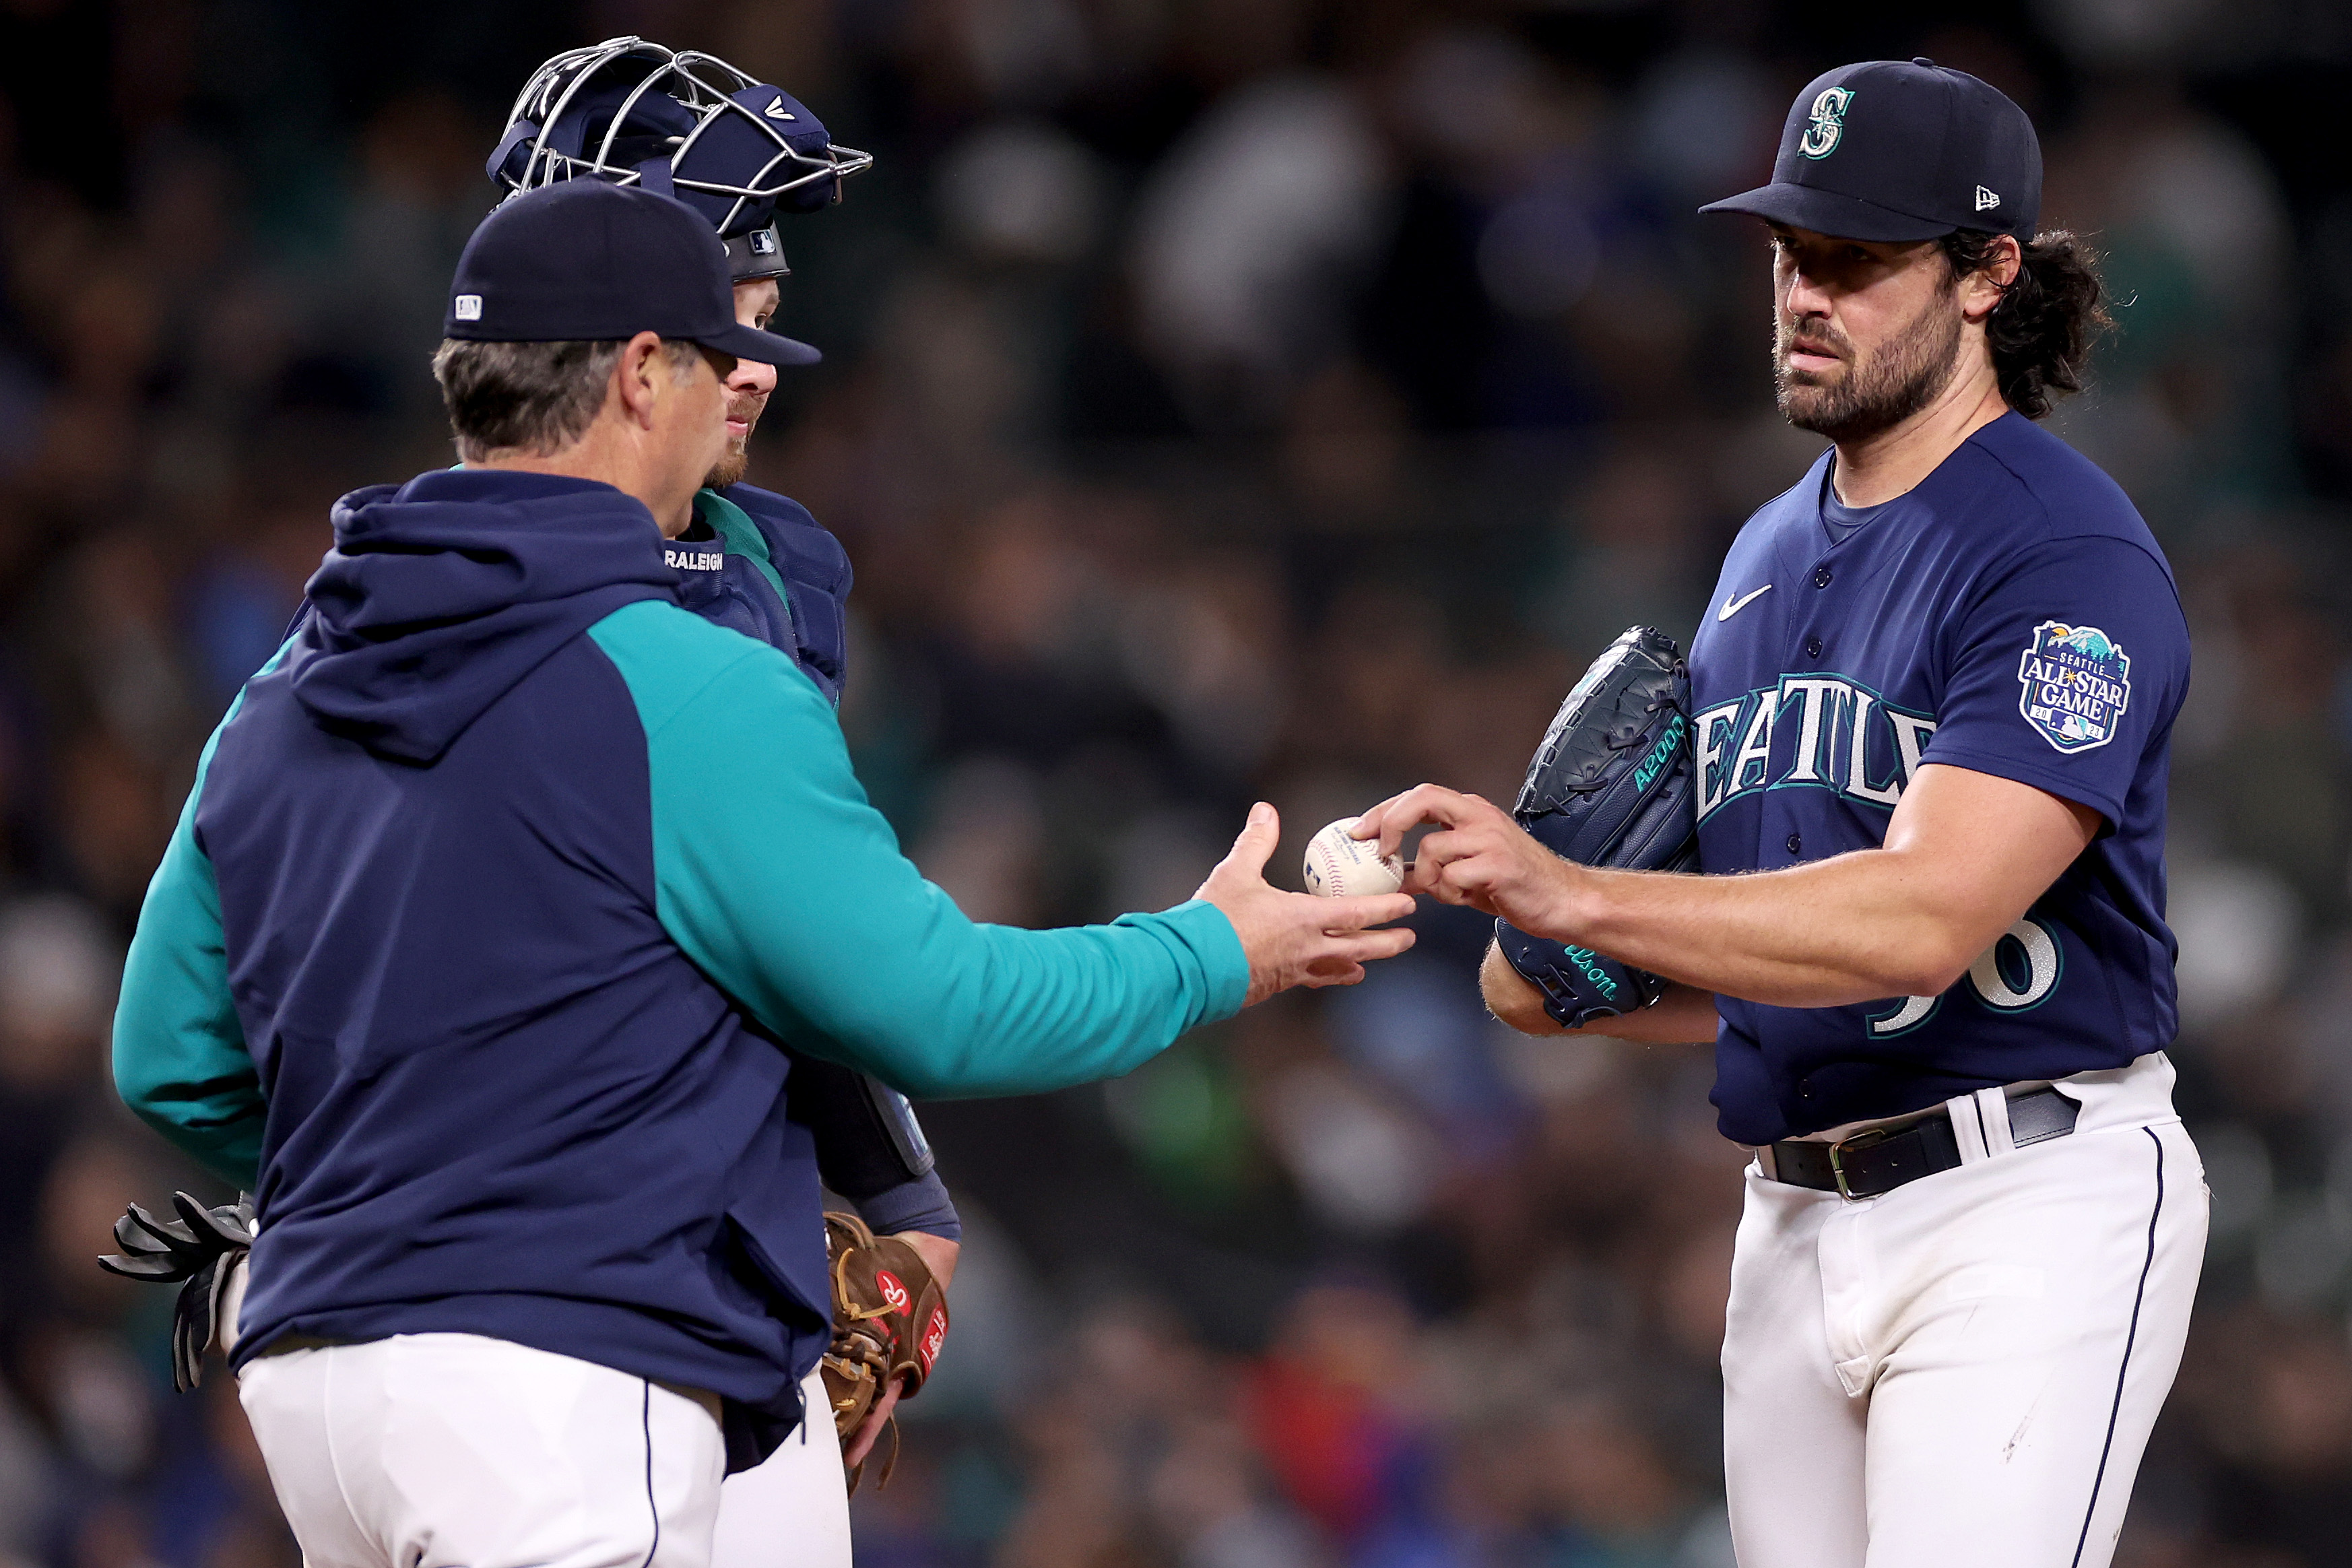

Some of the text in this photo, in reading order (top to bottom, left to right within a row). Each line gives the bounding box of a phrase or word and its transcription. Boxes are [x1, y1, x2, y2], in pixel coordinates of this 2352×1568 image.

[664, 550, 723, 571] RALEIGH
[2059, 652, 2105, 676] SEATTLE
[2041, 683, 2103, 721] GAME
[2074, 670, 2122, 707] STAR
[2035, 708, 2099, 736] 20 23
[1634, 715, 1684, 793] A2000
